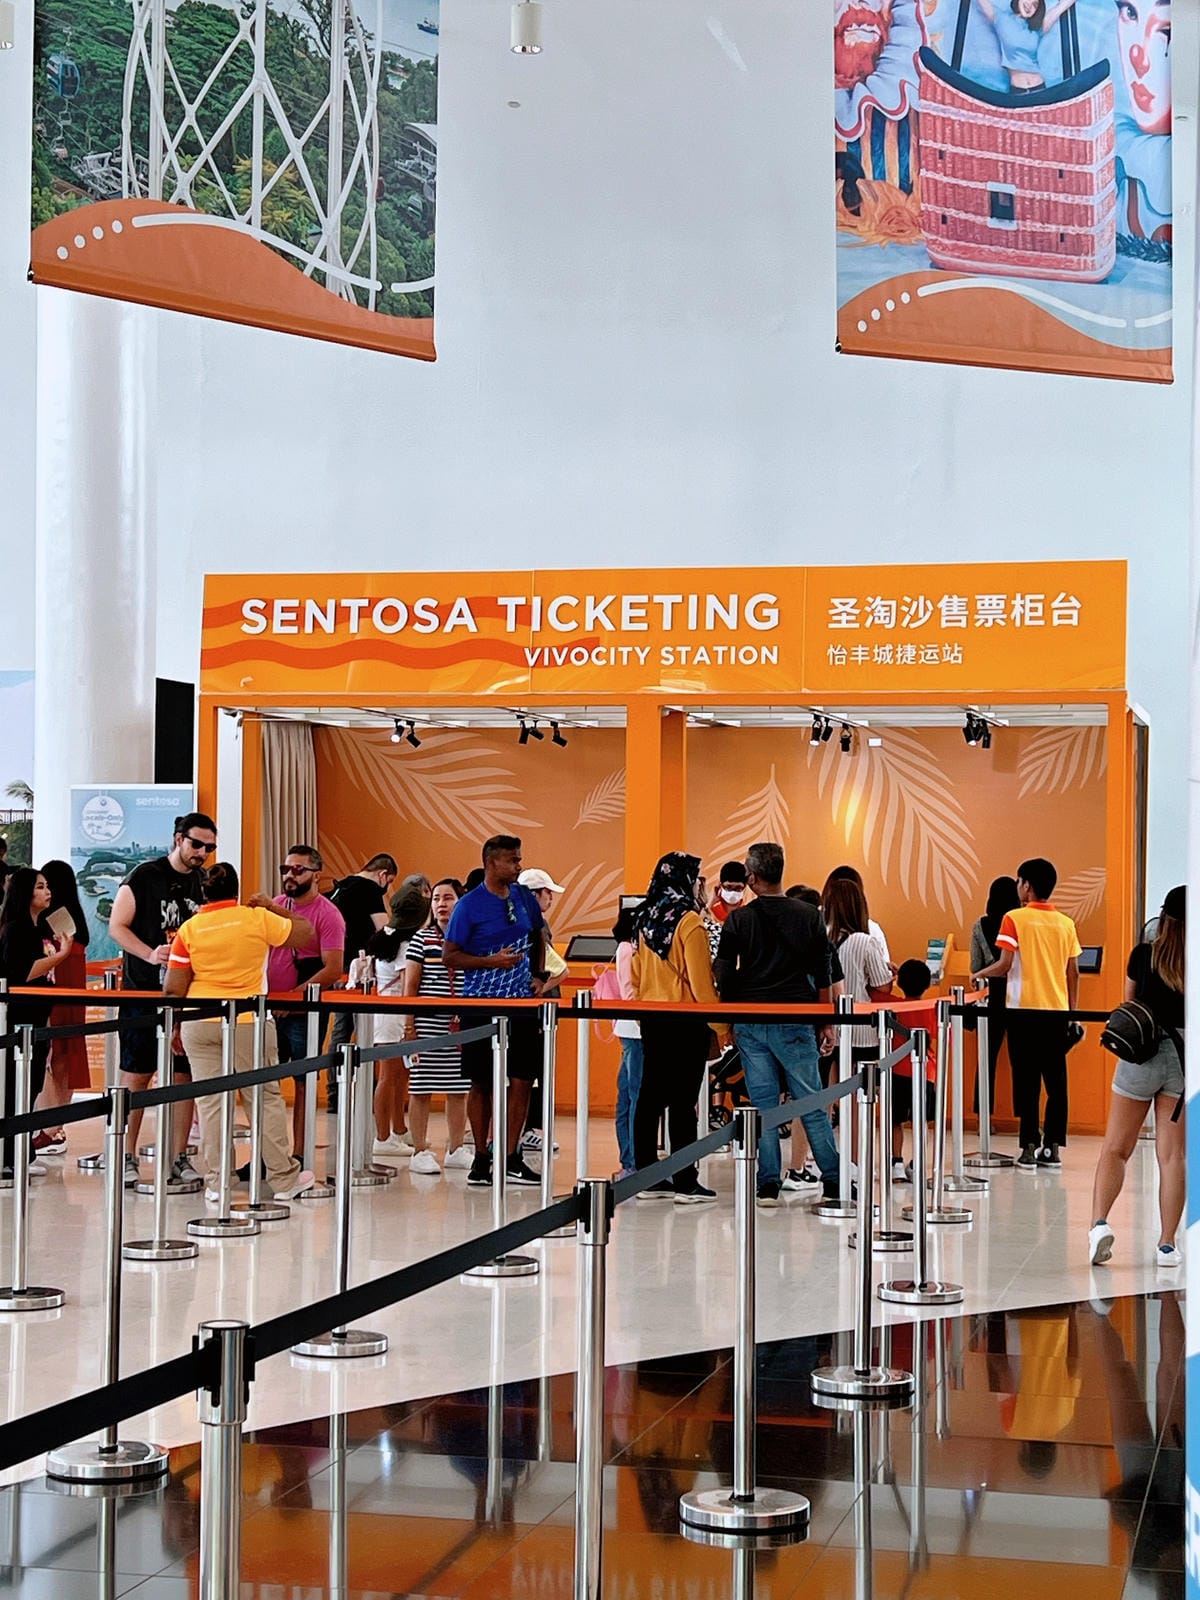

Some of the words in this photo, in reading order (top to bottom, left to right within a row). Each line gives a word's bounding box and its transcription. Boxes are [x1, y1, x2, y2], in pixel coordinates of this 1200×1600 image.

[241, 597, 478, 635] SENTOSA
[497, 593, 780, 632] TICKETING
[828, 592, 1081, 629] 圣淘沙售票柜台
[524, 646, 650, 667] VIVOCITY
[661, 645, 779, 666] STATION
[828, 643, 963, 665] 怡丰城捷运站
